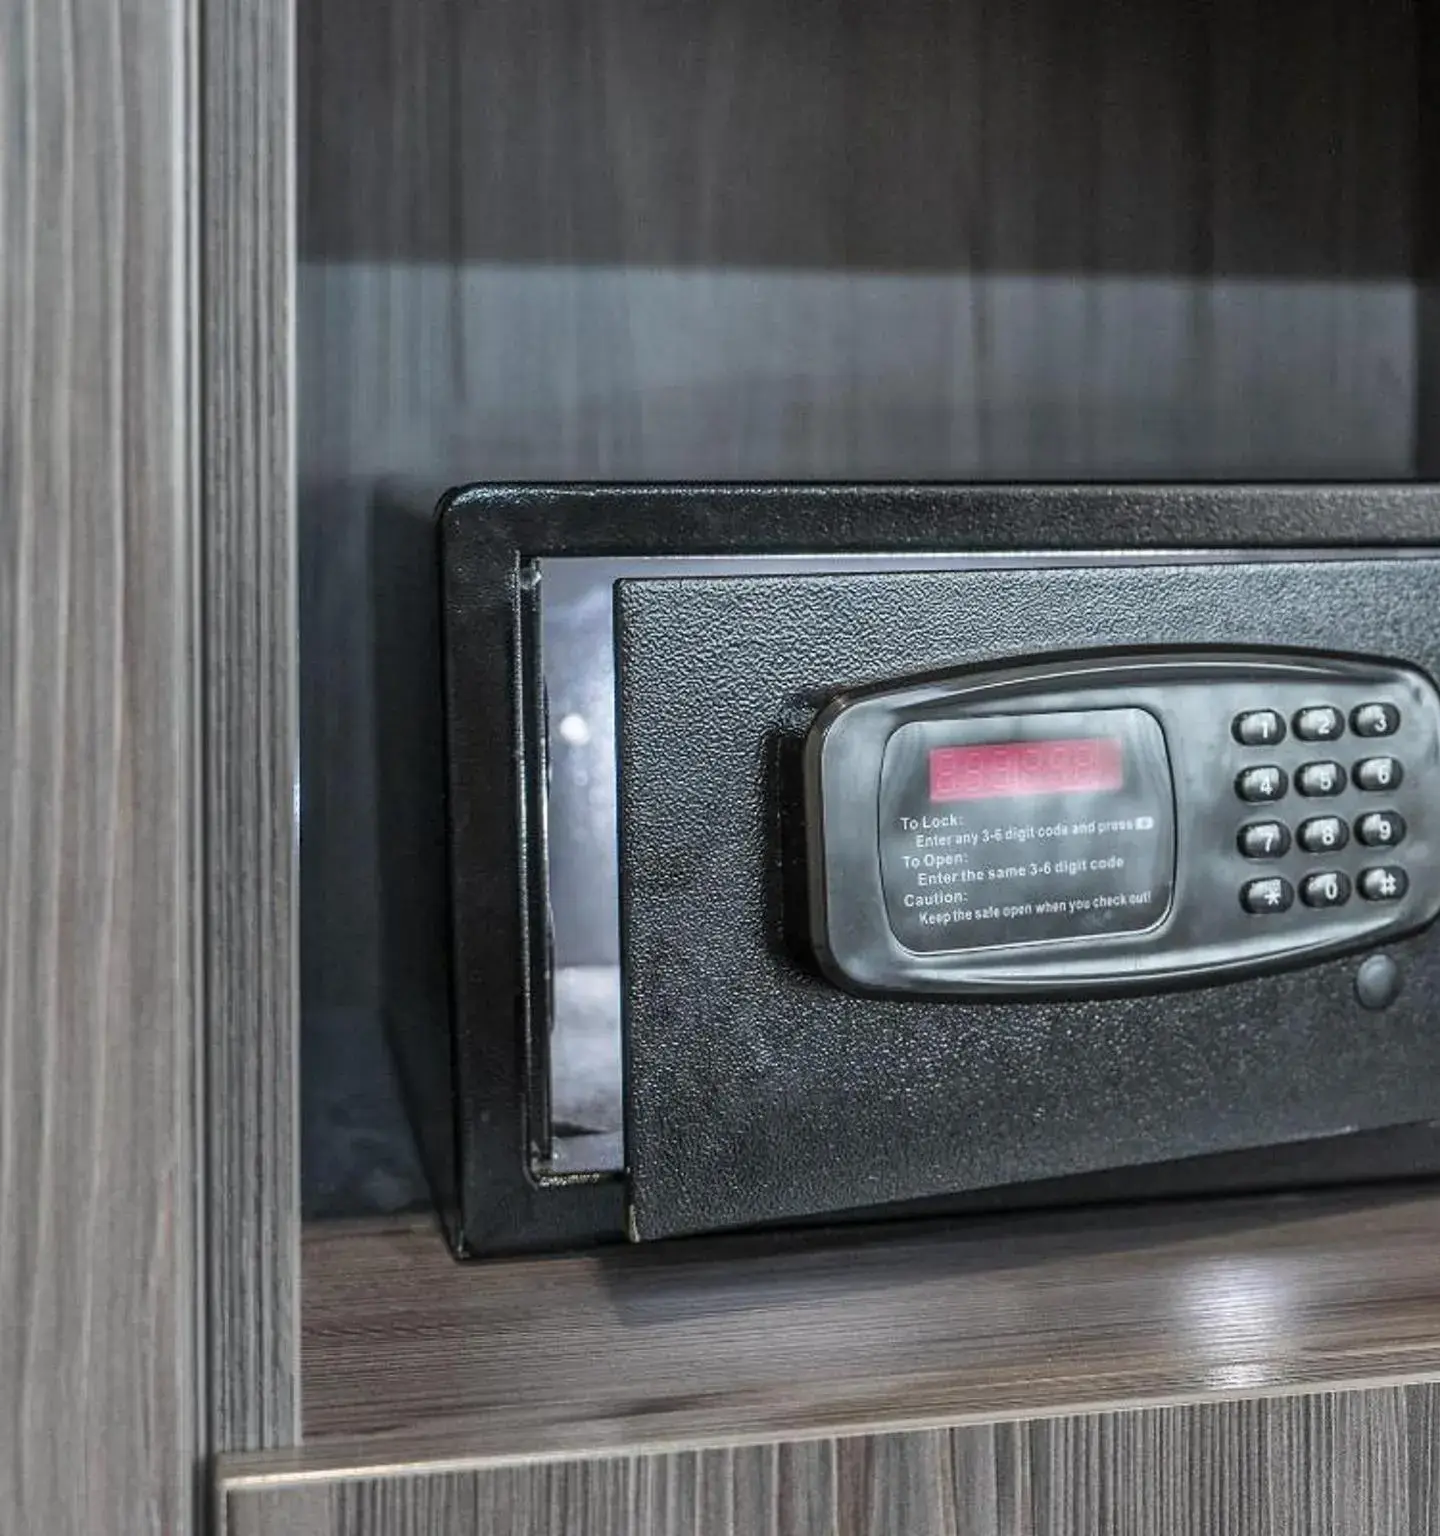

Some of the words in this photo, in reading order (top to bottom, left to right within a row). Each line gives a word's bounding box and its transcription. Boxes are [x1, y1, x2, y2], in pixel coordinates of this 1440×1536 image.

[1260, 719, 1271, 739] 1
[1316, 715, 1331, 735] 2
[1373, 713, 1389, 733] 3
[1260, 776, 1274, 796] 4
[1376, 765, 1391, 784] 6
[901, 816, 919, 830] To
[922, 813, 965, 829] Lock:
[915, 833, 953, 848] Enter
[955, 831, 978, 846] any
[982, 827, 1003, 843] 3-6
[1005, 825, 1035, 843] digit
[1038, 822, 1069, 838] code
[1072, 820, 1096, 835] and
[1097, 818, 1134, 835] press
[1261, 832, 1275, 852] 7
[1321, 826, 1336, 846] 8
[1377, 819, 1393, 841] 9
[901, 855, 920, 869] To
[923, 851, 969, 870] Open:
[917, 872, 959, 886] Enter
[960, 868, 984, 882] the
[987, 865, 1026, 881] same
[1029, 861, 1052, 876] 3-6
[1054, 858, 1088, 876] digit
[1089, 855, 1125, 871] code
[903, 889, 969, 908] Caution:
[1324, 878, 1338, 900] 0
[919, 910, 952, 927] Keep
[952, 907, 972, 922] the
[974, 905, 1000, 920] safe
[1002, 903, 1033, 919] open
[1036, 899, 1068, 916] when
[1068, 897, 1091, 914] you
[1091, 893, 1128, 910] check
